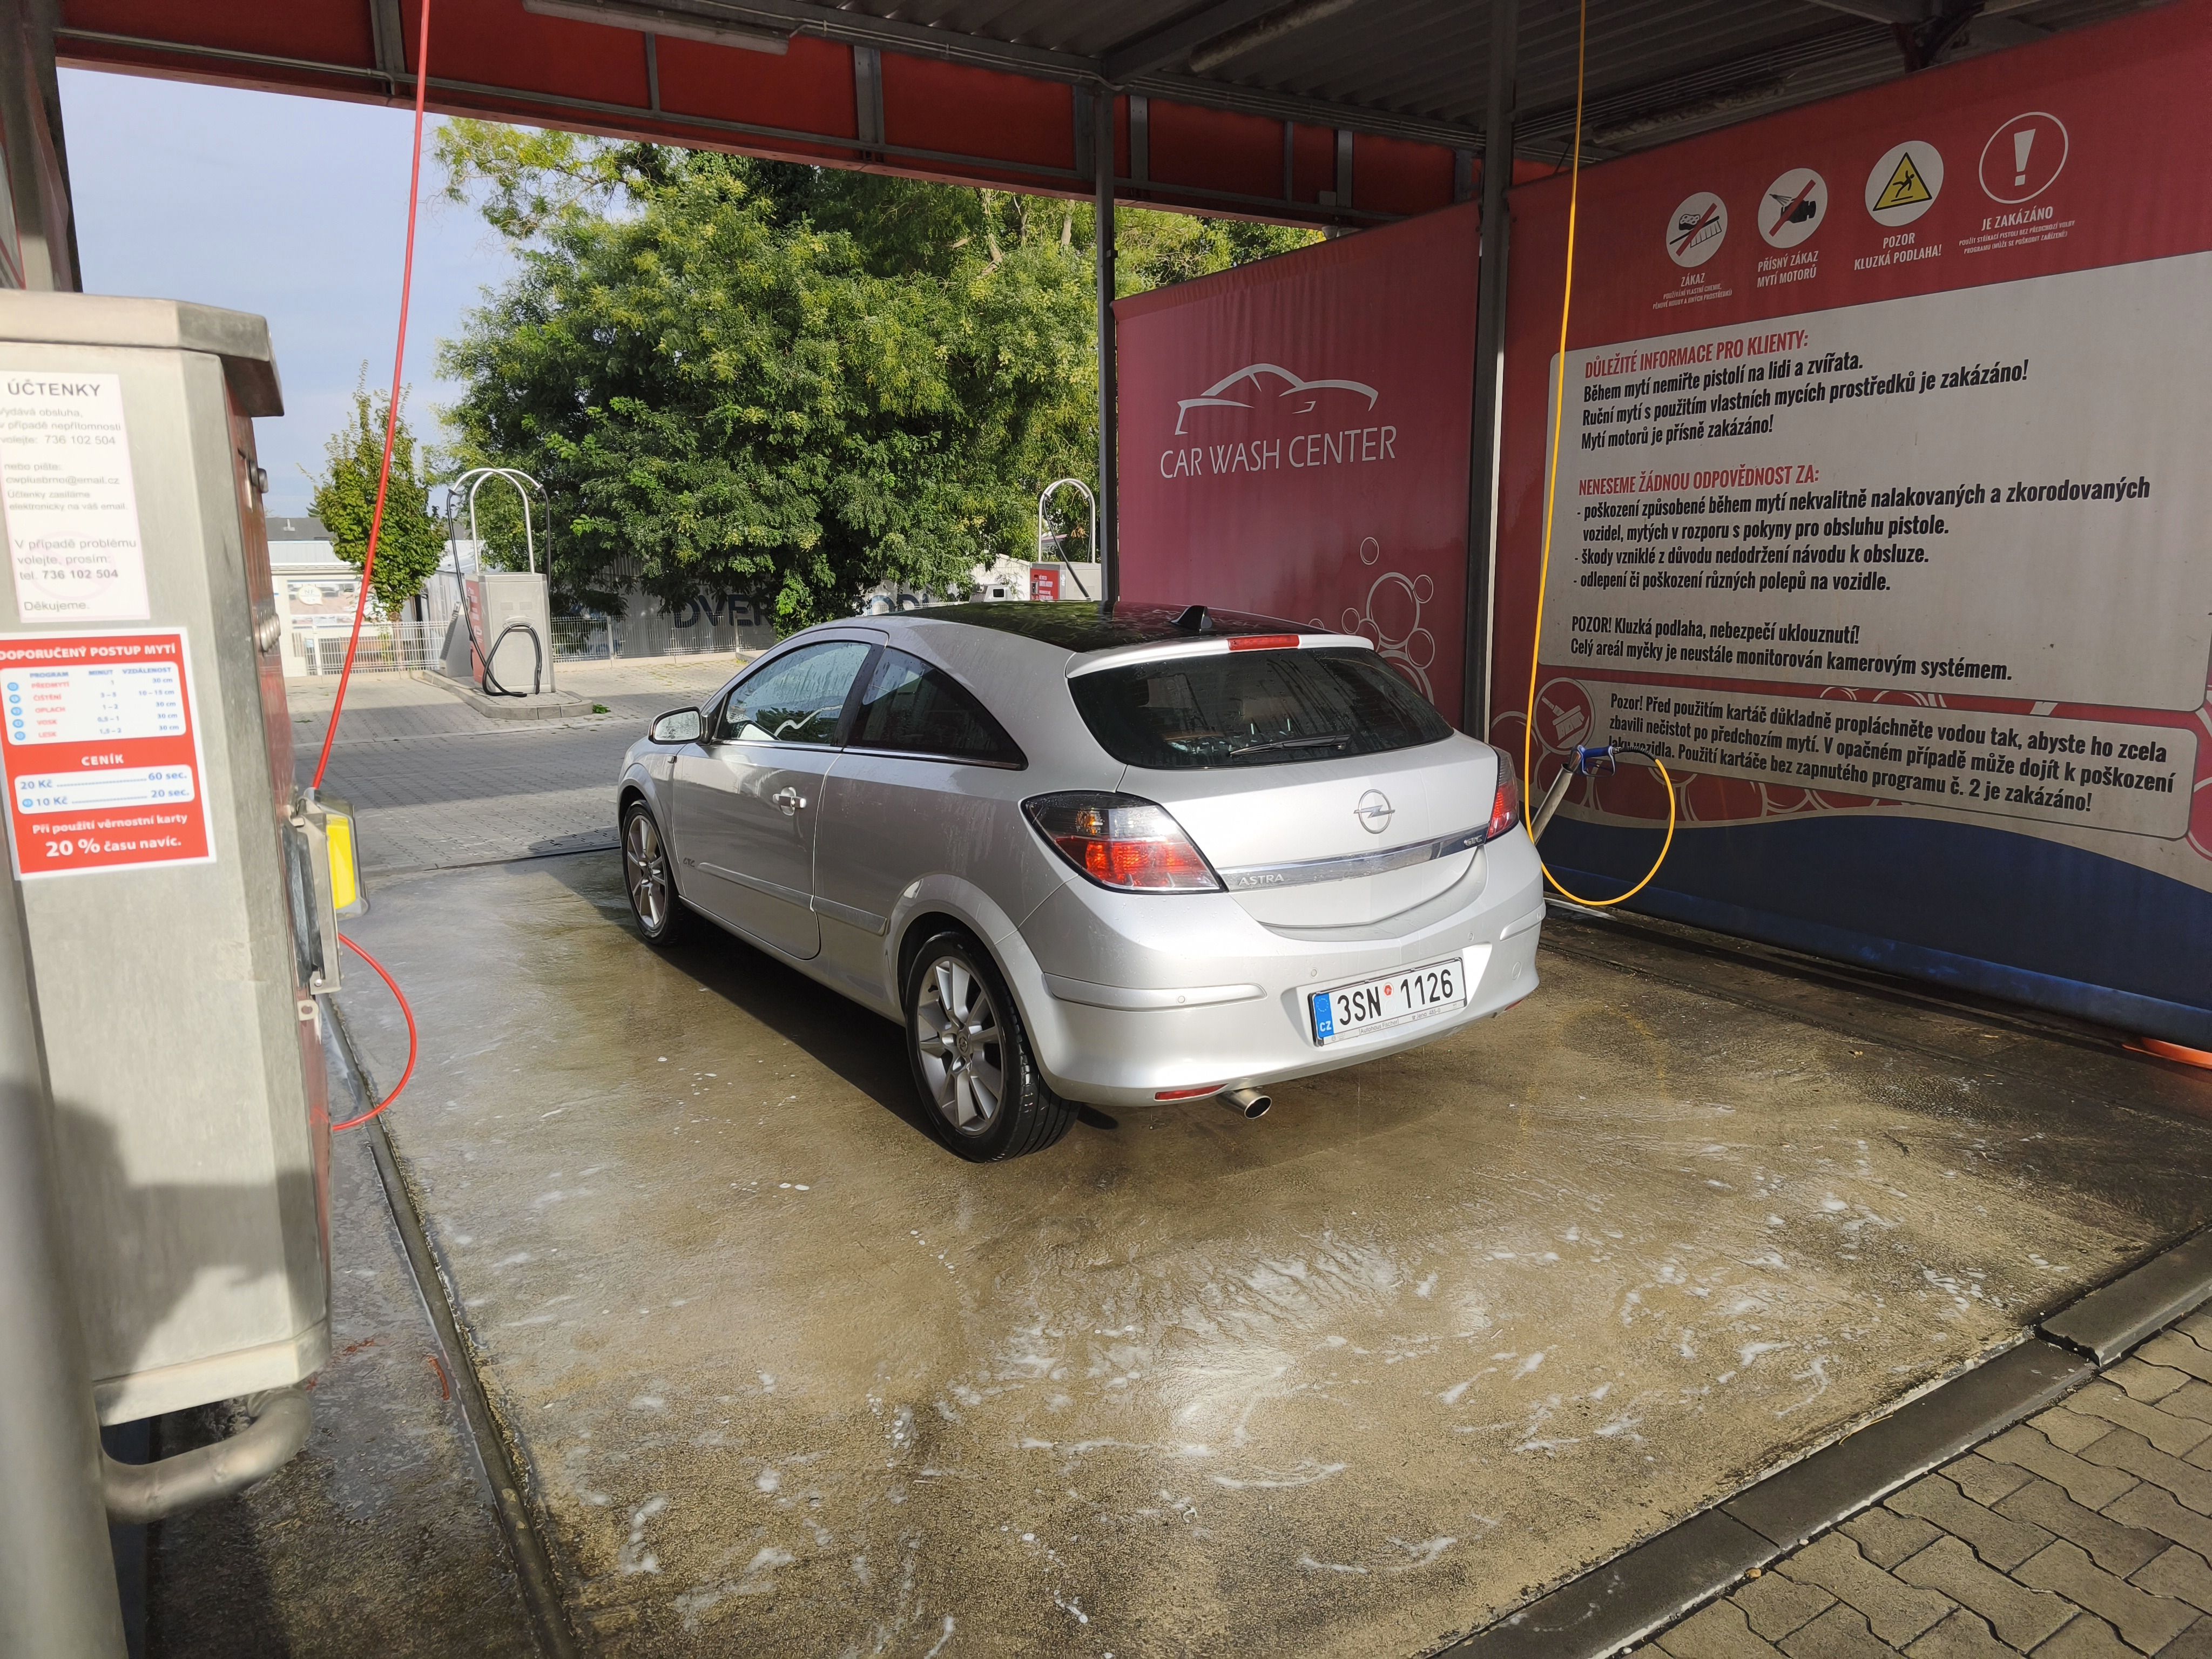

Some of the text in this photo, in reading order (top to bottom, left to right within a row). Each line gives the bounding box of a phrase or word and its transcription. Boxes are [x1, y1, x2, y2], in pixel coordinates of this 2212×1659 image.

[1981, 206, 2053, 231] JE ZAKÁZÁNO
[1883, 232, 1915, 249] POZOR
[1758, 251, 1818, 272] PŘÍSNÝ ZÁKAZ
[1854, 244, 1942, 270] KLUZKÁ PODLAHA!
[1681, 273, 1705, 287] ZÁKAZ
[1757, 264, 1817, 288] MYTÍ MOTORŮ
[1586, 330, 1808, 378] DŮLEŽITÉ INFORMACE PRO KLIENTY:
[8, 379, 100, 396] ÚČTENKY
[1584, 352, 1863, 402] Během mytí nemiřte pistolí na lidi a zvířata.
[1583, 359, 2028, 426] Ruční mytí s použitím vlastních mycích prostředků je zakázáno!
[1160, 426, 1398, 478] CAR WASH CENTER
[1579, 464, 1819, 495] NENESEME ŽÁDNOU ODPOVĚDNOST ZA:
[1584, 476, 2150, 521] poškození způsobené během mytí nekvalitně nalakovaných a zkorodovaných
[15, 539, 24, 549] V
[79, 539, 136, 549] problému
[42, 570, 65, 579] 736
[70, 569, 92, 579] 102
[96, 569, 118, 578] 504
[24, 601, 90, 612] Děkujeme.
[1572, 616, 1860, 644] POZOR! Kluzká podlaha, nebezpečí uklouznutí!
[0, 643, 176, 660] DOPORUČENÝ POSTUP MYTÍ
[1571, 638, 2012, 680] Celý areál myčky je neustále monitorován kamerovým systémem.
[122, 666, 172, 675] VZDÁLENOST
[1611, 693, 2166, 763] Pozor! Před použitím kartáč důkladně propláchněte vodou tak, abyste ho zcela
[81, 753, 125, 766] CENÍK
[1609, 715, 2176, 793] zbavili nečistot po předchozím mytí. V opačném případě může dojít k poškození
[20, 771, 187, 790] 20 Kč 60 sec.
[1678, 744, 1718, 763] Použití
[1720, 749, 1766, 770] kartáče
[1770, 755, 1792, 773] bez
[1796, 763, 1867, 783] zapnutého
[1872, 772, 1945, 793] programu
[1951, 776, 1964, 795] č.
[1969, 779, 1980, 797] 2
[1984, 781, 2000, 801] je
[2005, 785, 2092, 812] zakázáno!
[37, 788, 190, 806] 10 Kč 20 sec.
[32, 814, 187, 834] Při použití věrnostní karty
[45, 835, 181, 858] 20 % času navíc.
[1238, 874, 1284, 886] ASTRA
[1337, 969, 1453, 1026] 3SN 1126
[1319, 1021, 1332, 1032] CZ
